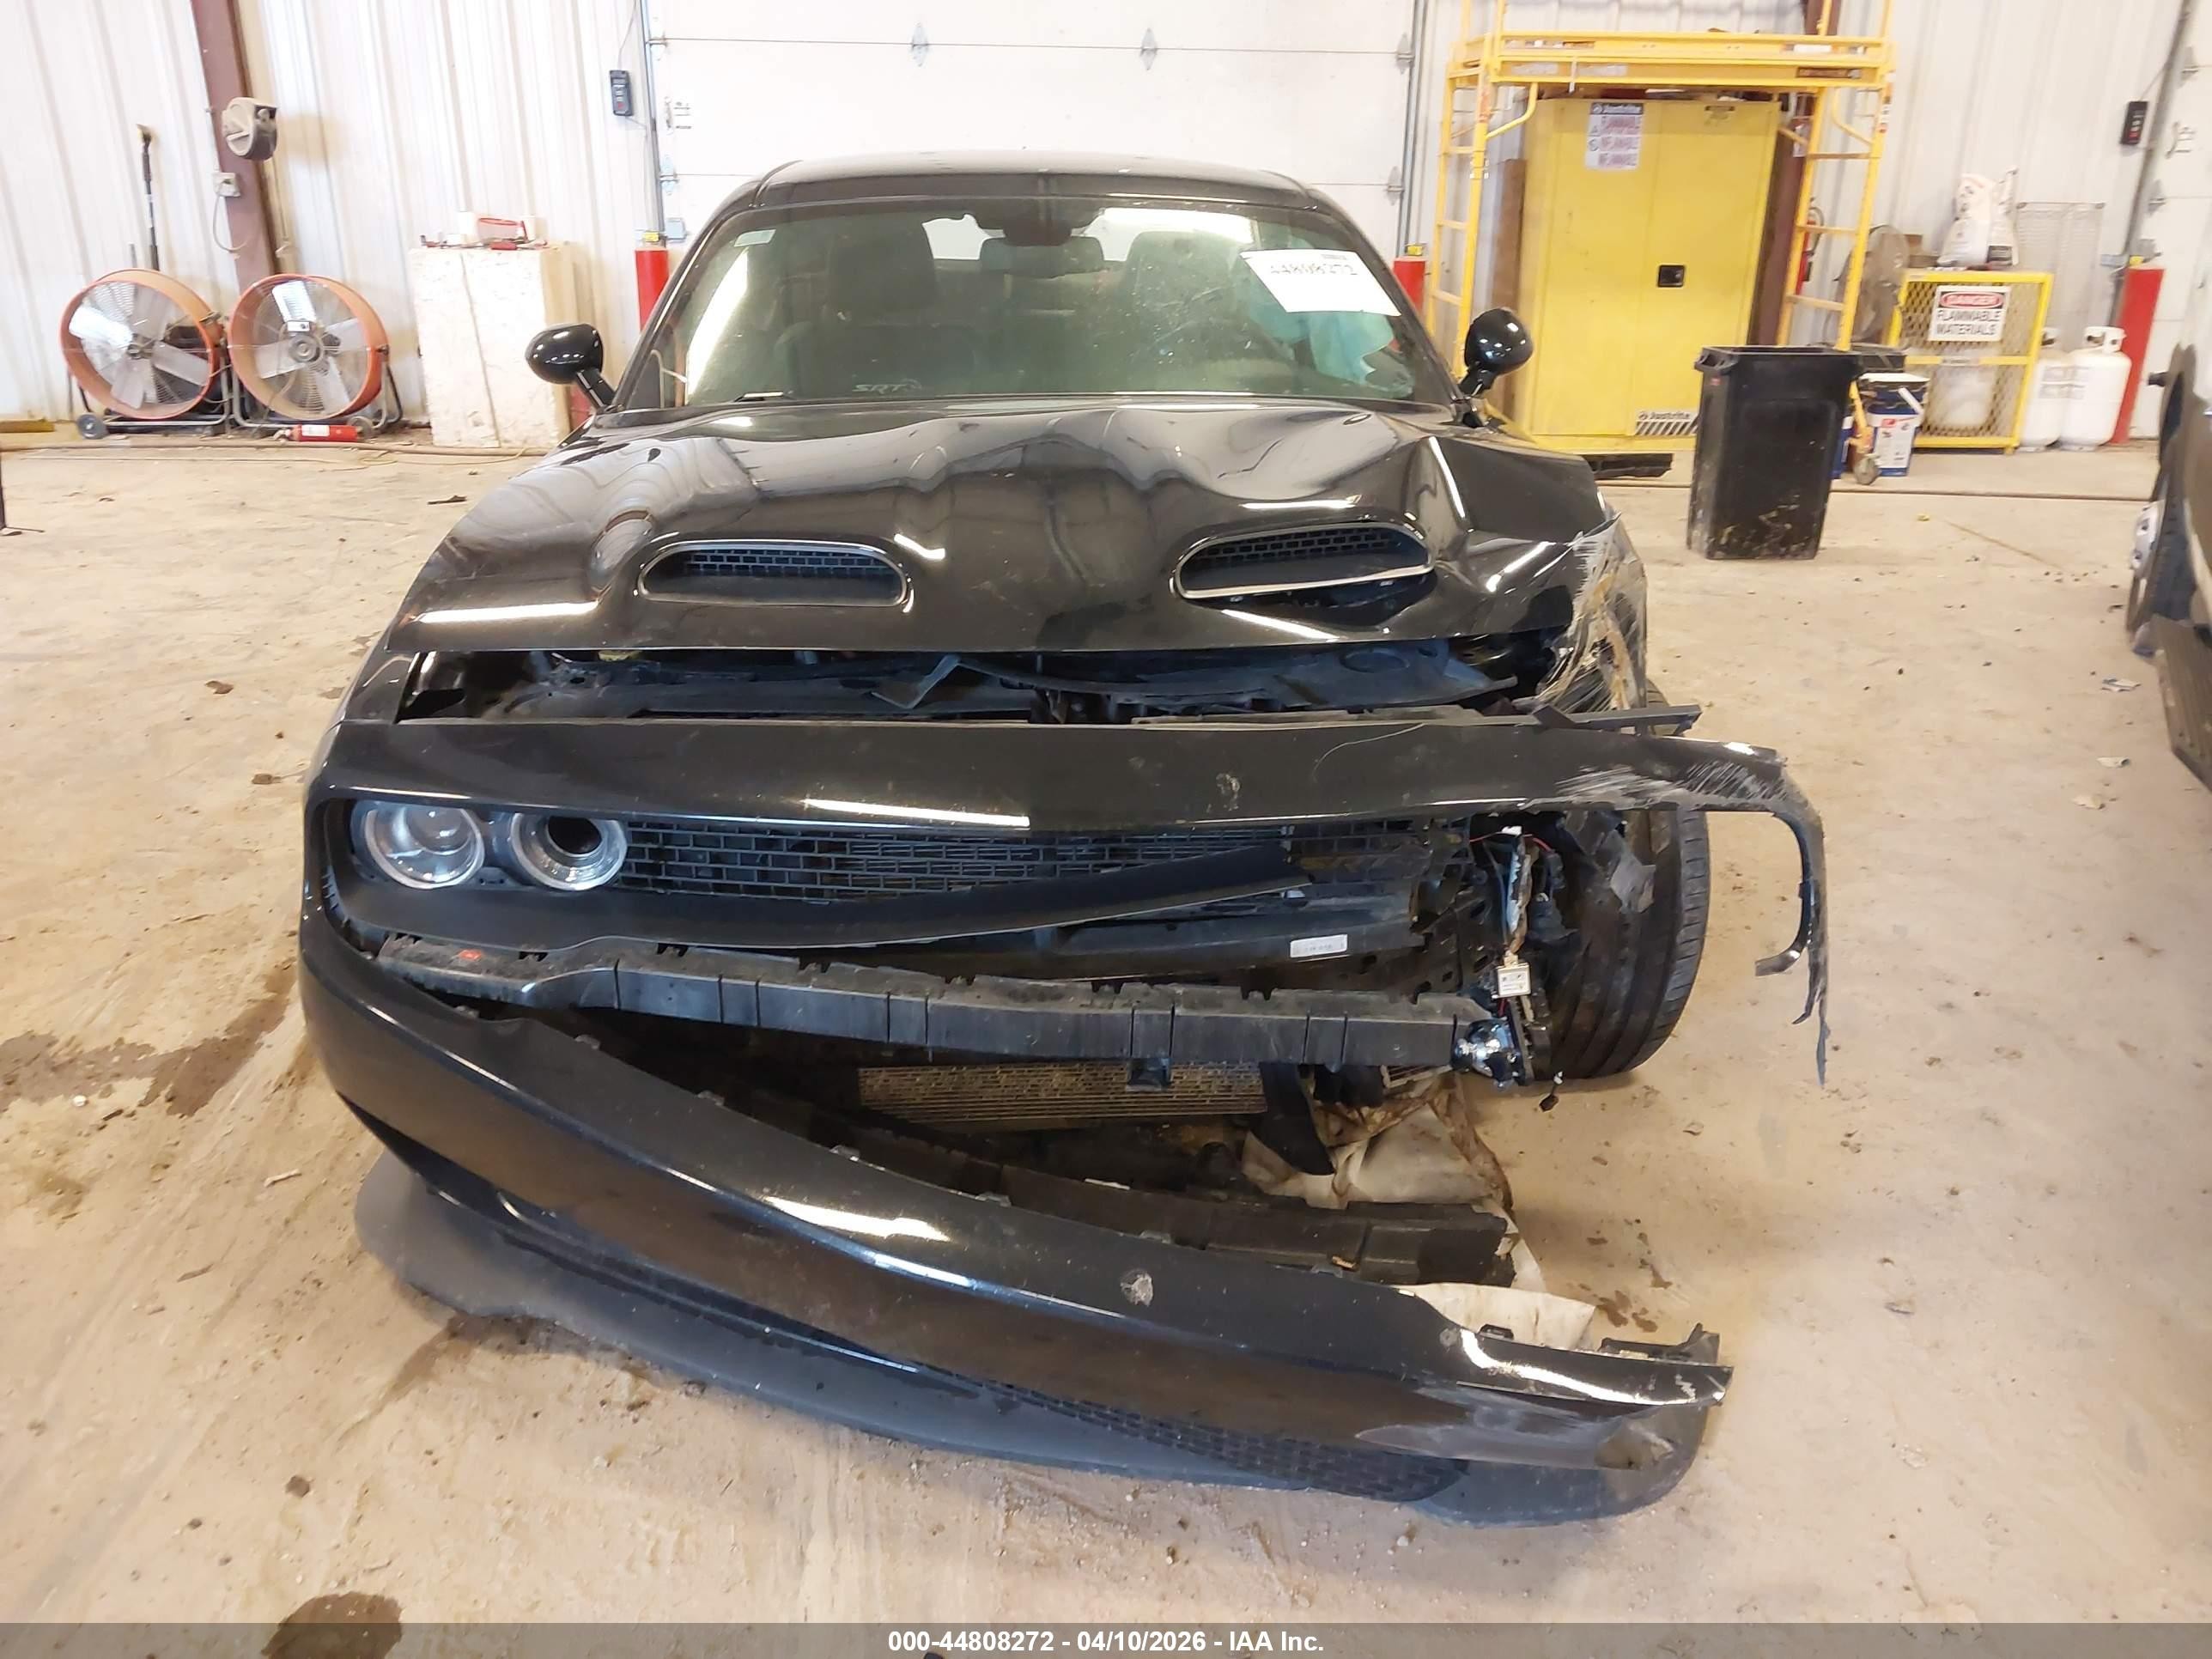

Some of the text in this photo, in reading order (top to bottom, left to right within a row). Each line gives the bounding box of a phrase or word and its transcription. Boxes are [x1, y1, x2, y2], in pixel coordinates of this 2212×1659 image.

[1937, 310, 2001, 321] FLAMMABLE
[1936, 324, 1995, 335] MATERIALS
[852, 384, 907, 394] SRT
